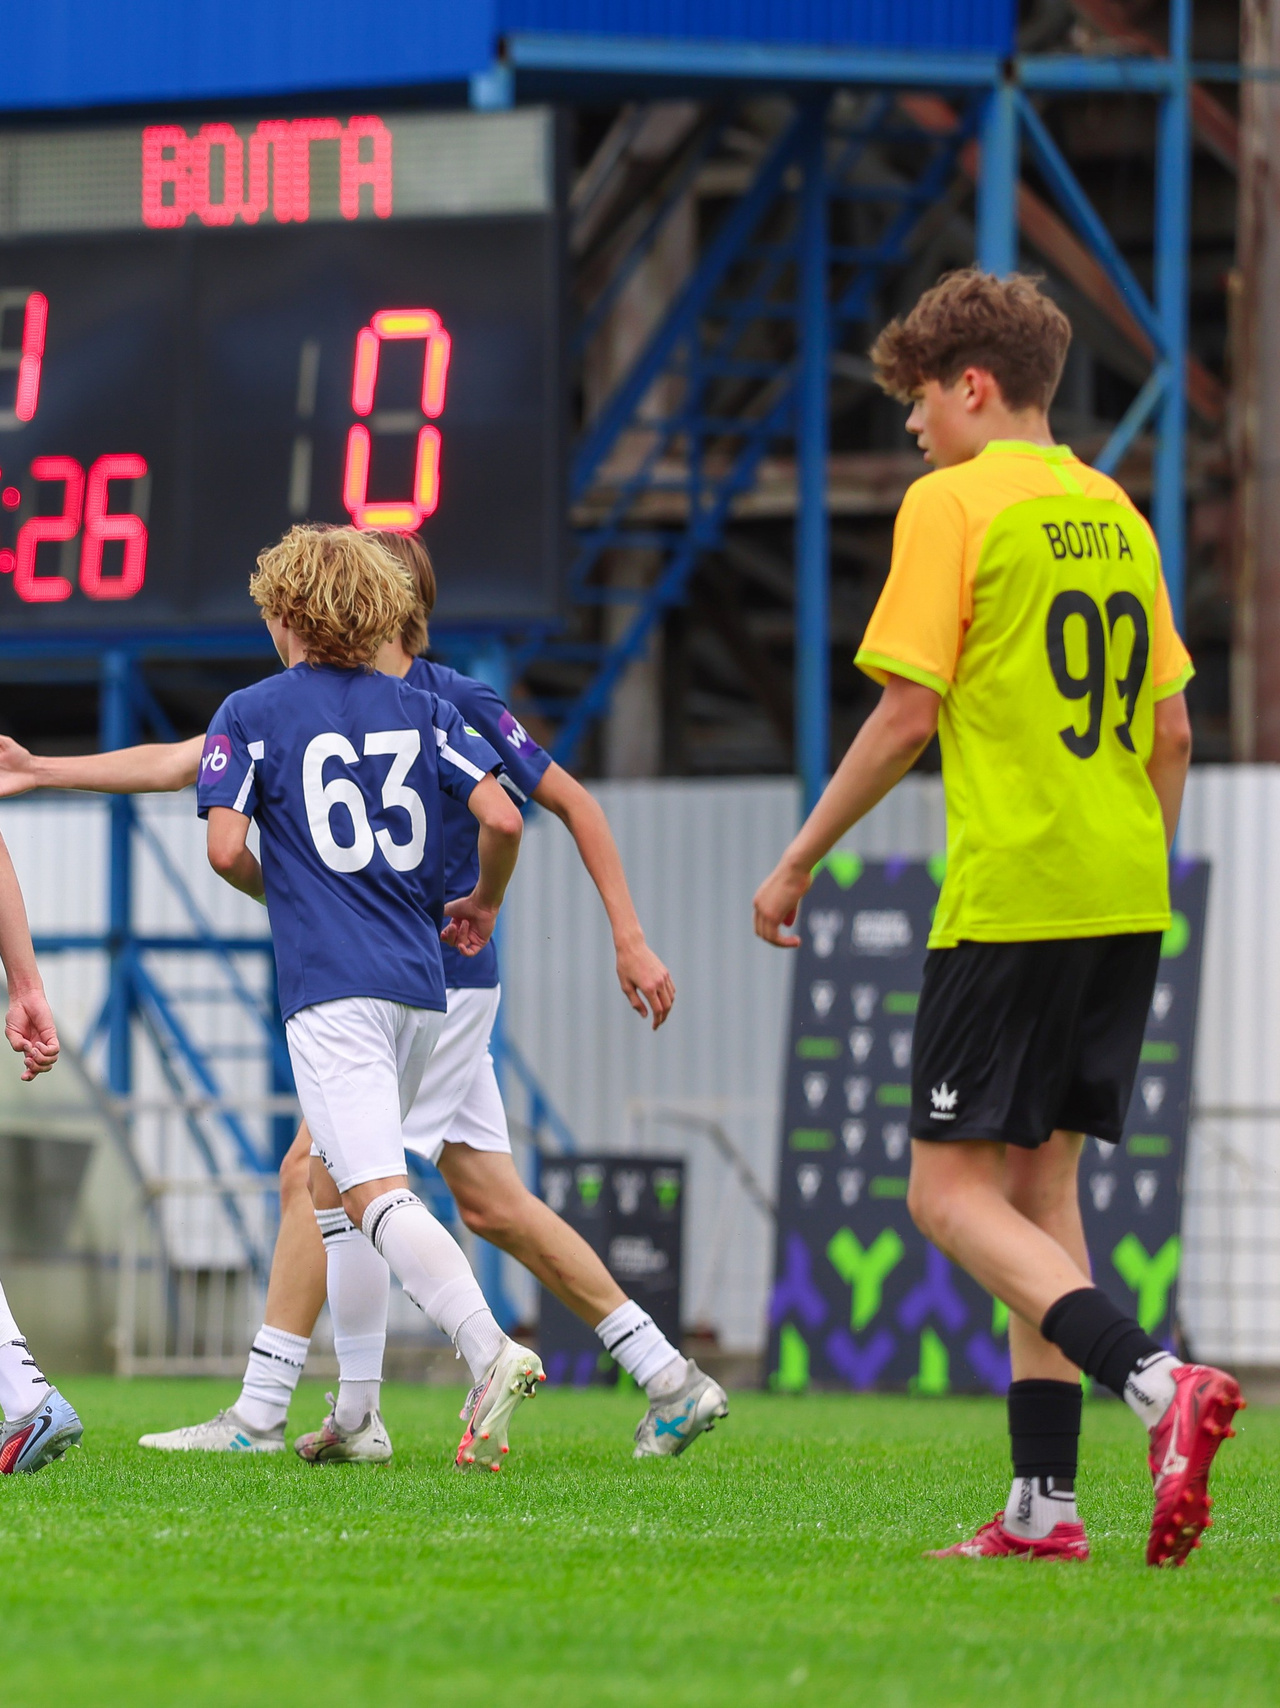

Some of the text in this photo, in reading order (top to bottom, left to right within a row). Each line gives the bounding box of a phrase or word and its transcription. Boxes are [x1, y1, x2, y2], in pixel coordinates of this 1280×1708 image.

[142, 115, 393, 229] ВОЛГА
[14, 292, 49, 422] 1
[342, 308, 452, 531] 0
[1041, 520, 1134, 562] ВОЛГА
[1045, 589, 1150, 761] 99
[302, 728, 427, 874] 63
